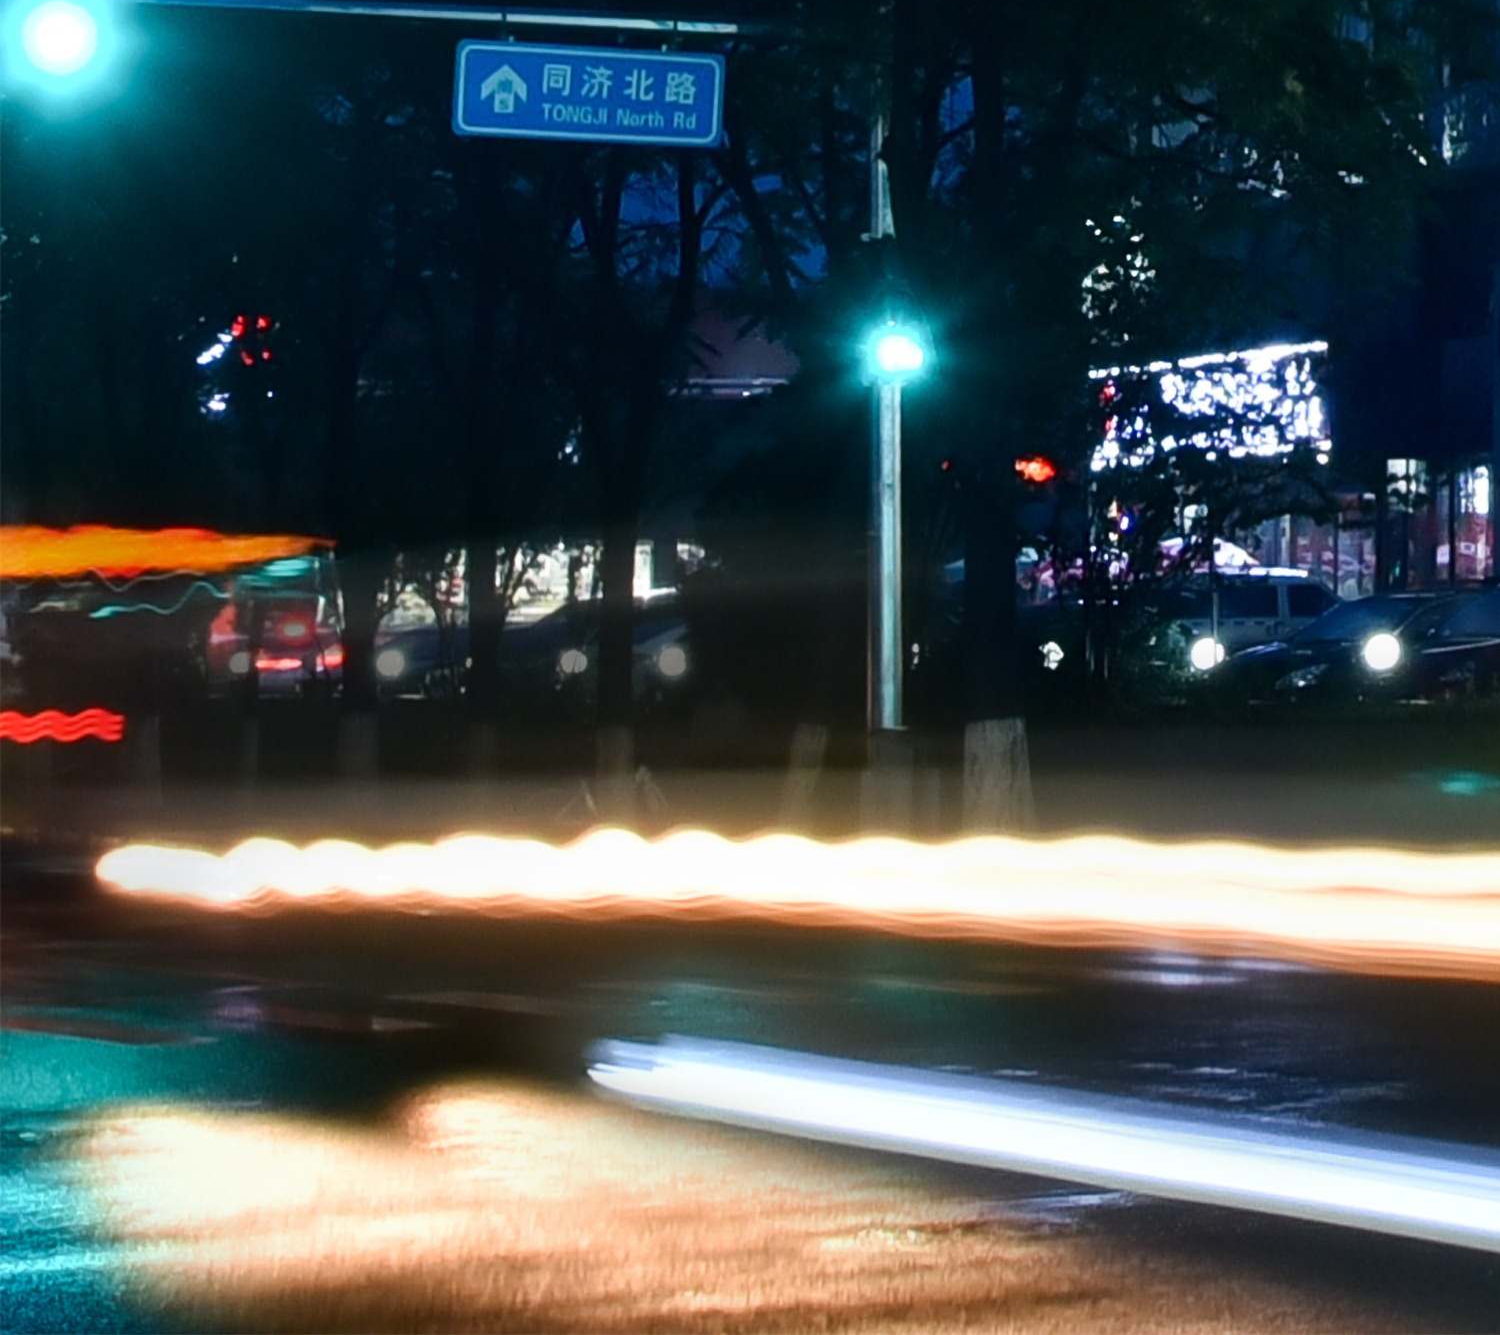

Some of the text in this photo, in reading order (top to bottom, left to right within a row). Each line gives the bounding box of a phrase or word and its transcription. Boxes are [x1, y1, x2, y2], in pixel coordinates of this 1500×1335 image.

[542, 63, 696, 105] 同济北路
[541, 103, 696, 129] TONGJI North Rd
